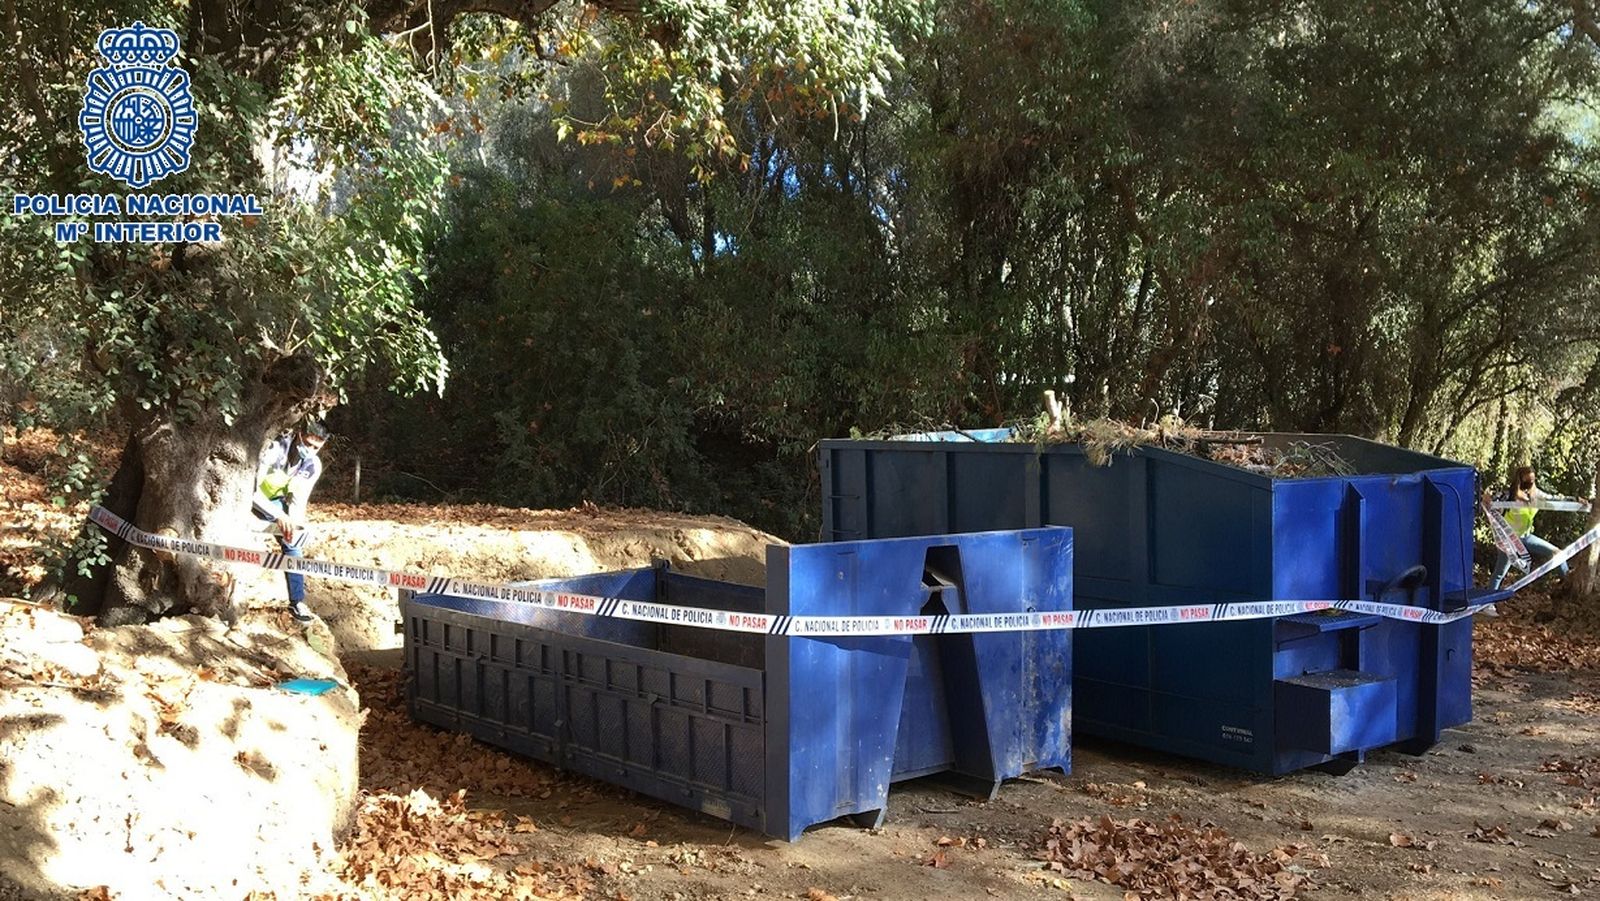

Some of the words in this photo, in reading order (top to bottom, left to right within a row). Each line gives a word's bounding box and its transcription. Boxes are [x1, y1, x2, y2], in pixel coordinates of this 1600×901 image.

[171, 540, 180, 551] DE
[182, 542, 209, 556] POLICIA
[224, 549, 236, 560] NO
[237, 551, 261, 564] PASAR
[296, 561, 332, 575] NACIONAL
[334, 564, 343, 576] DE
[345, 566, 374, 581] POLICIA
[389, 573, 400, 585] NO
[402, 574, 426, 588] PASAR
[462, 583, 500, 599] NACIONAL
[501, 587, 511, 600] DE
[513, 588, 542, 603] POLICIA
[557, 595, 569, 607] NO
[570, 596, 594, 610] PASAR
[632, 605, 668, 620] NACIONAL
[671, 608, 681, 621] DE
[683, 609, 713, 624] POLICIA
[729, 614, 740, 626] NO
[742, 616, 767, 629] PASAR
[1104, 612, 1134, 623] NACIONAL
[1135, 611, 1143, 621] DE
[1145, 610, 1168, 621] POLICIA
[1180, 608, 1189, 619] NO
[1190, 608, 1209, 619] PASAR
[1238, 605, 1265, 616] NACIONAL
[1266, 604, 1274, 614] DE
[804, 620, 839, 632] NACIONAL
[841, 620, 850, 632] DE
[852, 619, 879, 632] POLICIA
[894, 619, 904, 630] NO
[905, 618, 928, 630] PASAR
[960, 616, 992, 629] NACIONAL
[994, 616, 1002, 627] DE
[1004, 615, 1029, 627] POLICIA
[1042, 614, 1052, 625] NO
[1053, 613, 1073, 625] PASAR
